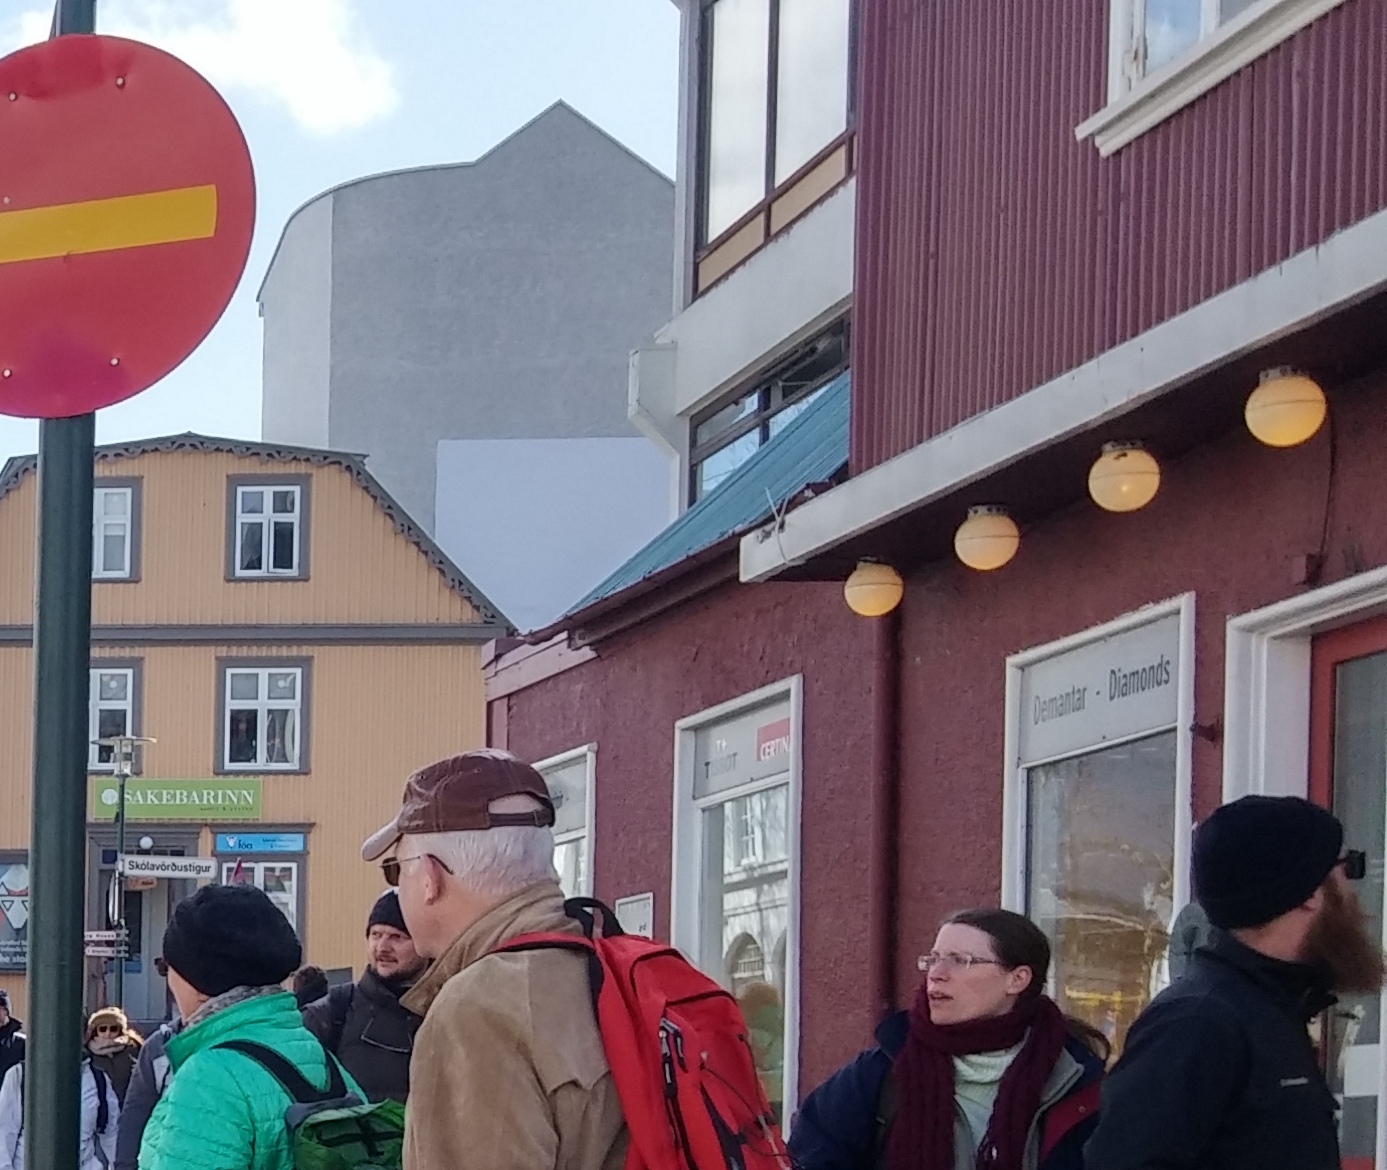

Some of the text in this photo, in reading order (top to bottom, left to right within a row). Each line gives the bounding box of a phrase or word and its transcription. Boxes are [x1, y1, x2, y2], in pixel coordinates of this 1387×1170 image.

[1033, 684, 1087, 725] Demantar
[1109, 654, 1171, 702] Diamonds
[760, 735, 791, 761] CERTIN
[124, 789, 255, 805] SAKEBARINN
[128, 860, 212, 875] Skólavörðustígur
